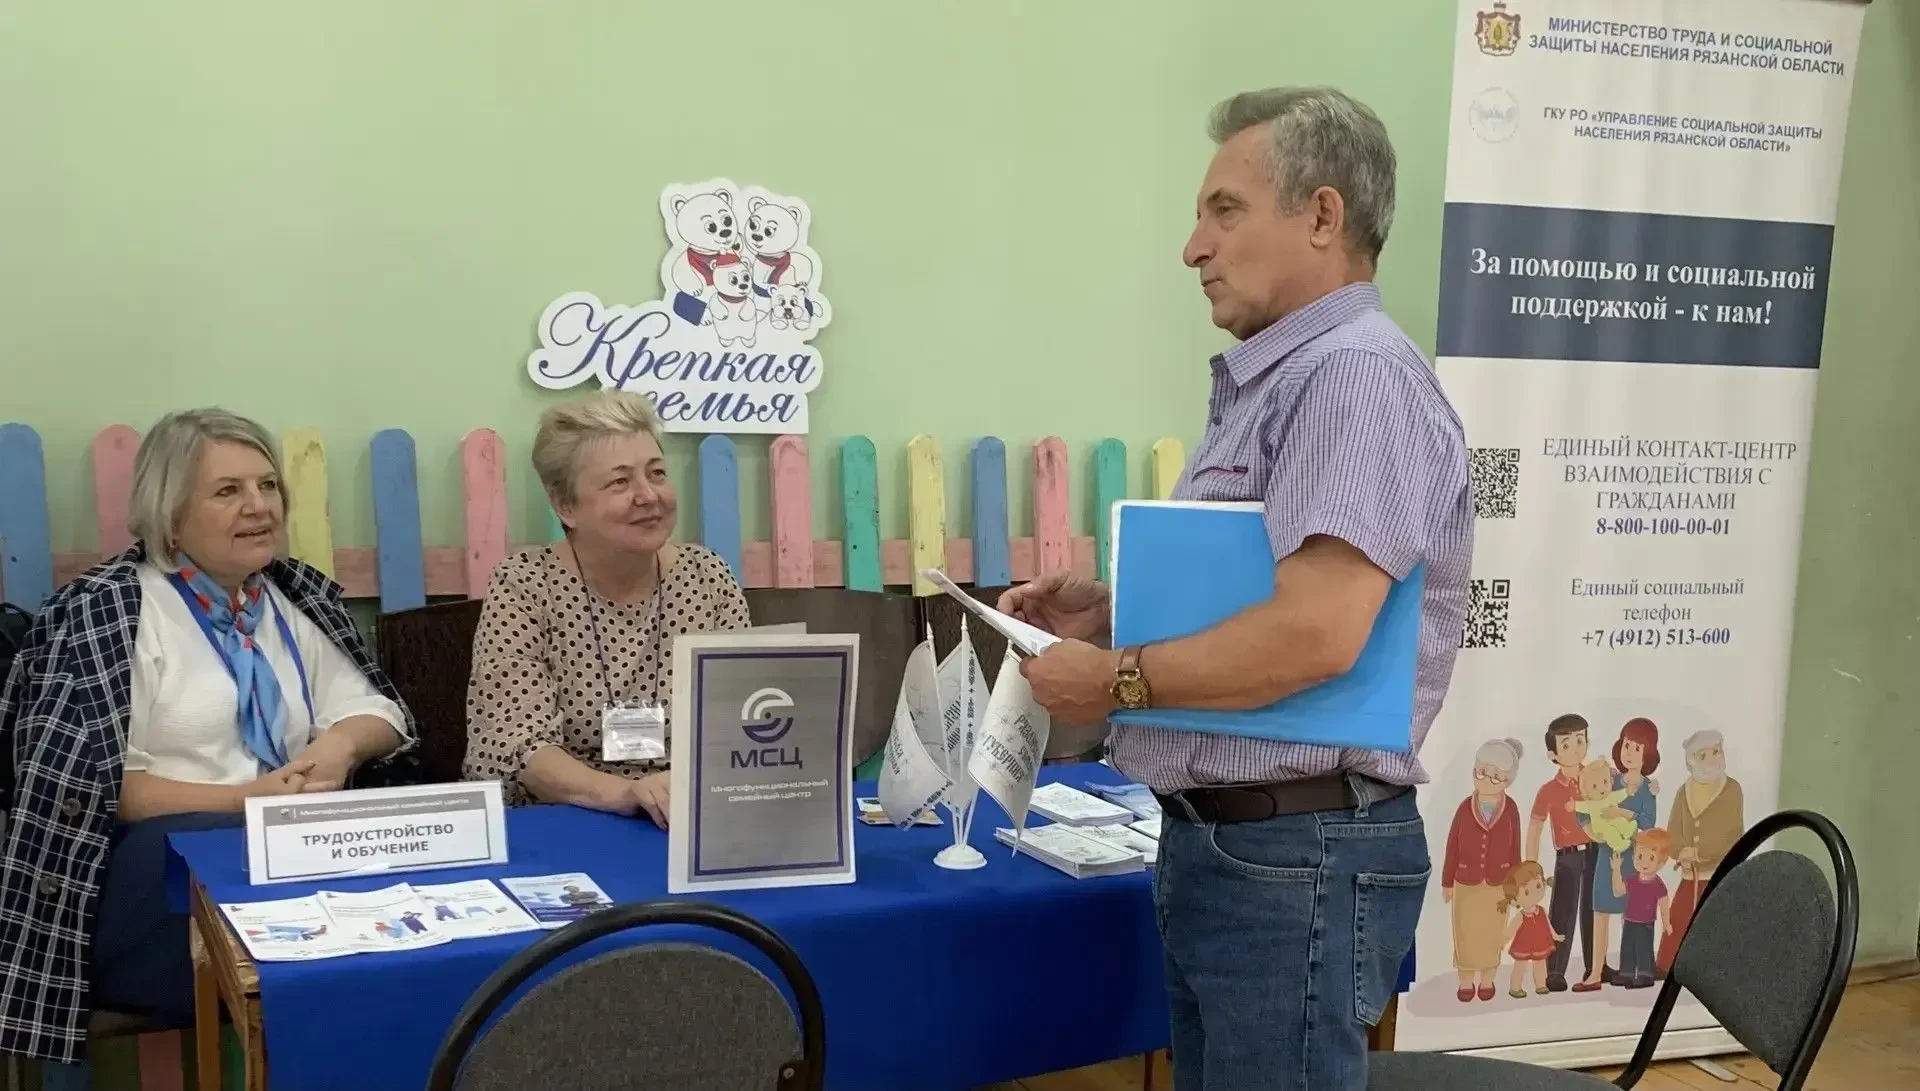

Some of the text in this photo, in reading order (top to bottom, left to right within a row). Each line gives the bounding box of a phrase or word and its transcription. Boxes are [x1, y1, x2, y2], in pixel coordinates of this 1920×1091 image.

[1548, 17, 1833, 56] МИНИСТЕРСТВО ТРУДА И СОЦИАЛЬНОЙ
[1528, 34, 1845, 76] ЗАЩИТЫ НАСЕЛЕНИЯ РЯЗАНСКОЙ ОБЛАСТИ
[1543, 107, 1823, 140] ГКУ РО «УПРАВЛЕНИЕ СОЦИАЛЬНОЙ ЗАЩИТЫ
[1574, 126, 1792, 153] НАСЕЛЕНИЯ РЯЗАНСКОЙ ОБЛАСТИ»
[1470, 247, 1816, 291] За помощью и социальной
[1511, 294, 1668, 325] поддержкой
[1692, 305, 1709, 322] к
[1716, 300, 1773, 325] нам!
[538, 302, 816, 389] Крепкая
[644, 390, 799, 423] емья
[1542, 435, 1797, 461] ЕДИНЫЙ КОНТАКТ-ЦЕНТР
[1564, 464, 1773, 486] ВЗАИМОДЕЙСТВИЯ С
[1596, 491, 1736, 511] ГРАЖДАНАМИ
[1596, 517, 1731, 536] 8-800-100-00-01
[1570, 578, 1744, 598] Единый социальный
[1623, 604, 1692, 624] телефон
[1581, 628, 1731, 651] +7 (4912) 513-600
[731, 747, 803, 769] МСЦ
[301, 823, 454, 846] ТРУДОУСТРОЙСТВО
[332, 841, 429, 860] И ОБУЧЕНИЕ
